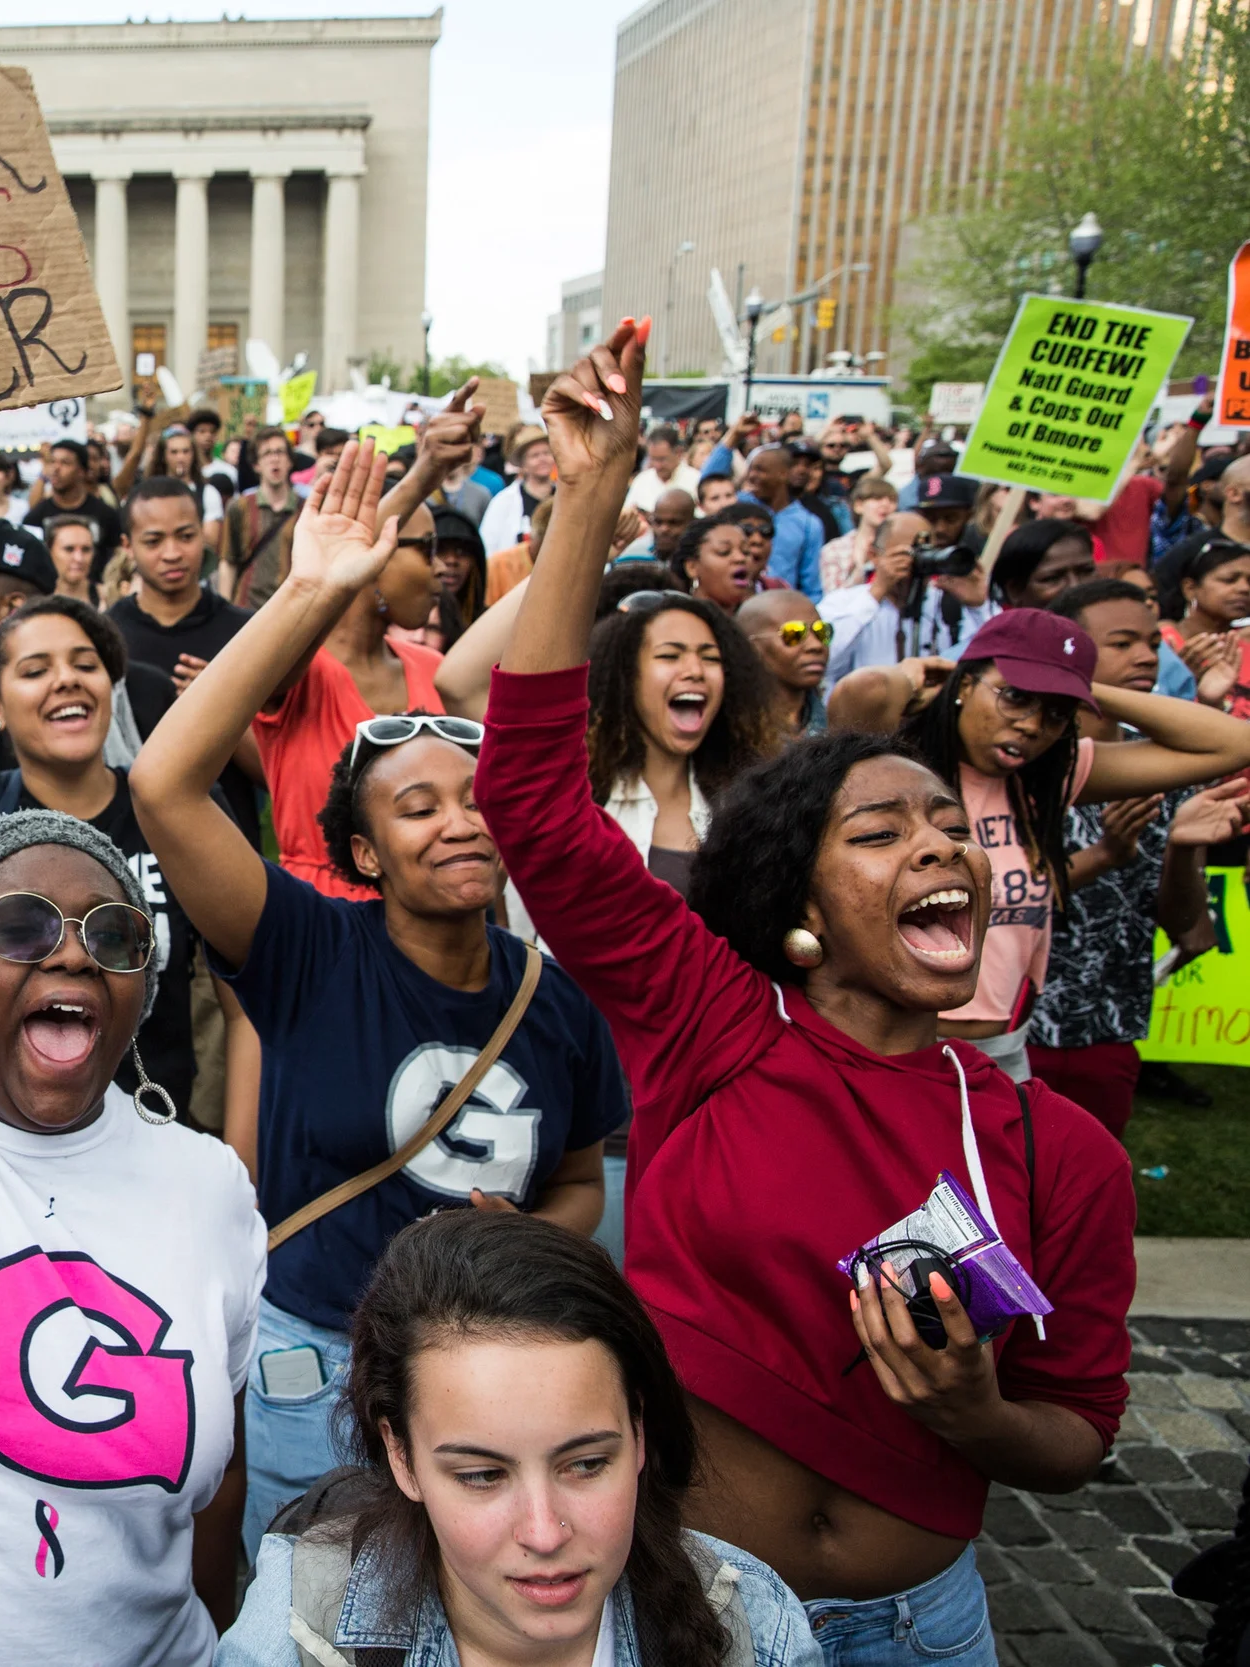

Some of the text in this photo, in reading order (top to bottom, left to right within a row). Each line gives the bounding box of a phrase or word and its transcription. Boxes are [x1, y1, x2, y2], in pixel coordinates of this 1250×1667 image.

[1047, 312, 1152, 350] END THE
[1029, 339, 1147, 380] CURFEW!
[1066, 377, 1133, 406] Guard
[1008, 396, 1124, 431] & Cops Out
[1007, 420, 1102, 454] of Bmore
[385, 1041, 543, 1204] G
[942, 1185, 980, 1237] Nutrition Facts
